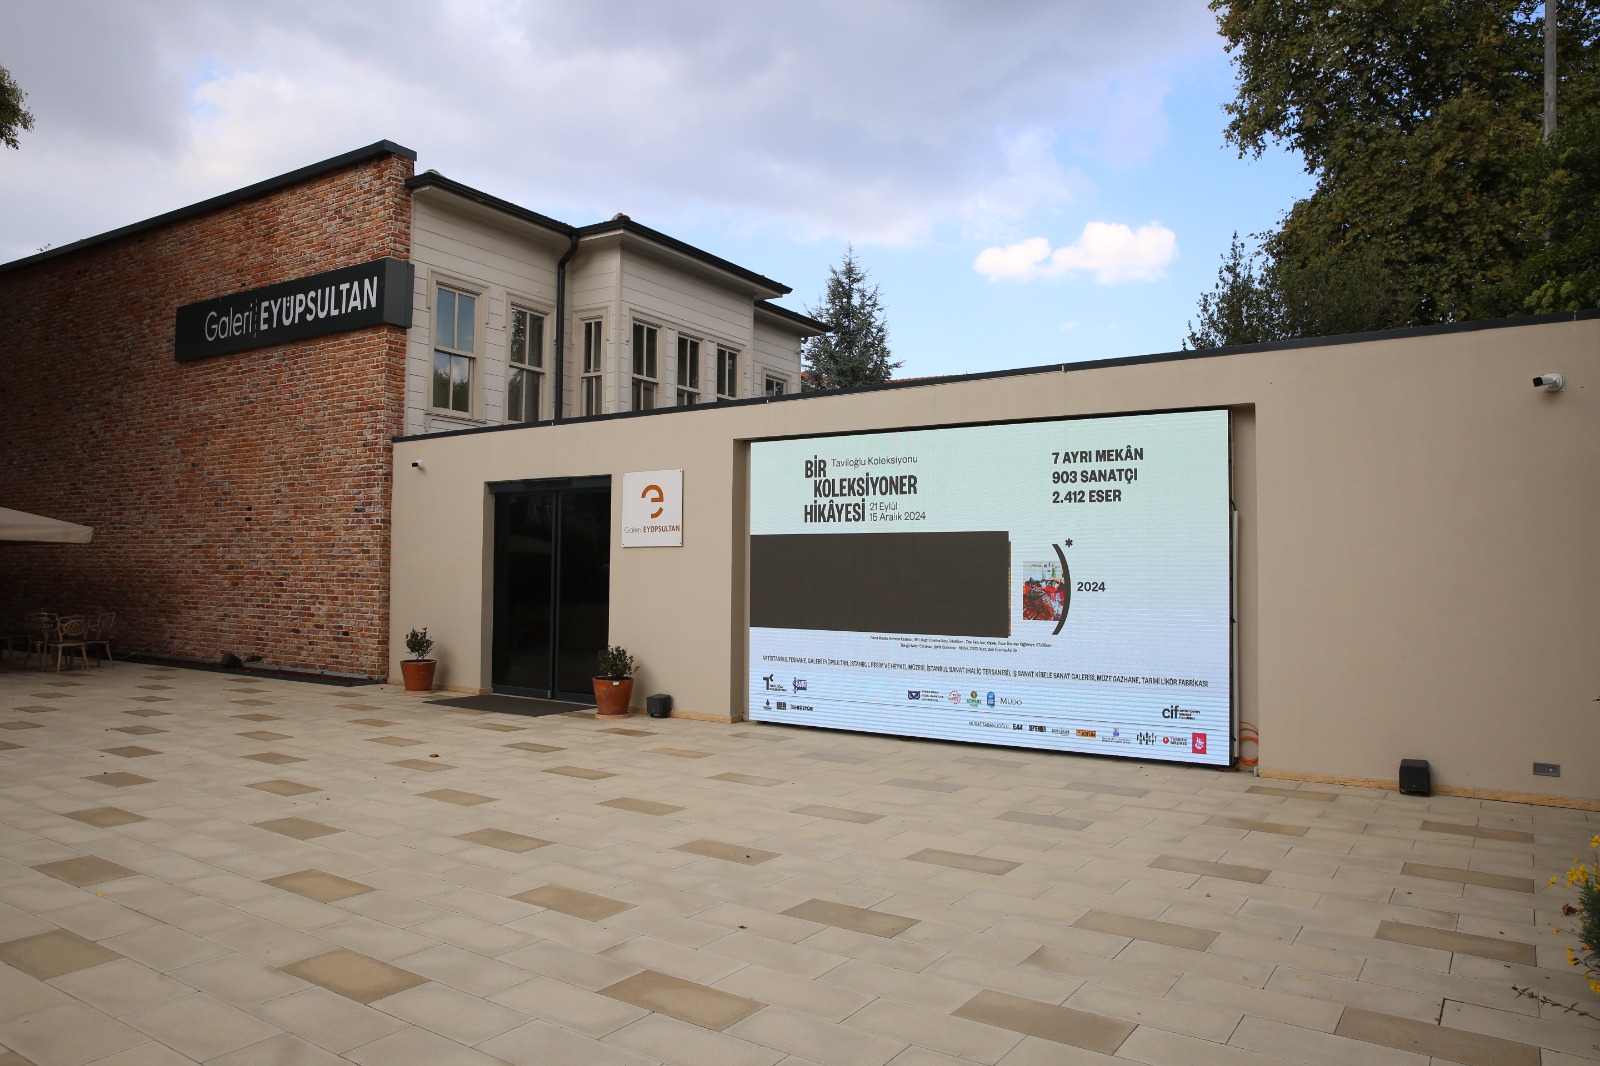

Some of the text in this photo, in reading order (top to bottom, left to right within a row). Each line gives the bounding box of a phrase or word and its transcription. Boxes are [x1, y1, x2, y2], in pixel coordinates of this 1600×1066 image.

[204, 276, 378, 342] Galeri EYÜPSULTAN
[831, 455, 918, 470] Taviloğlu Koleksiyonu
[1052, 445, 1144, 465] 7 AYRI MEKÂN
[804, 454, 827, 479] BİR
[1052, 468, 1138, 484] 903 SANATÇI
[813, 472, 918, 498] KOLEKSİYONER
[1052, 489, 1122, 503] 2.412 ESER
[804, 498, 866, 523] HİKÂYESİ
[869, 501, 898, 512] 21 Eylül
[869, 511, 927, 522] 15 Aralık 2024
[1077, 581, 1106, 592] 2024
[1162, 705, 1179, 719] cif
